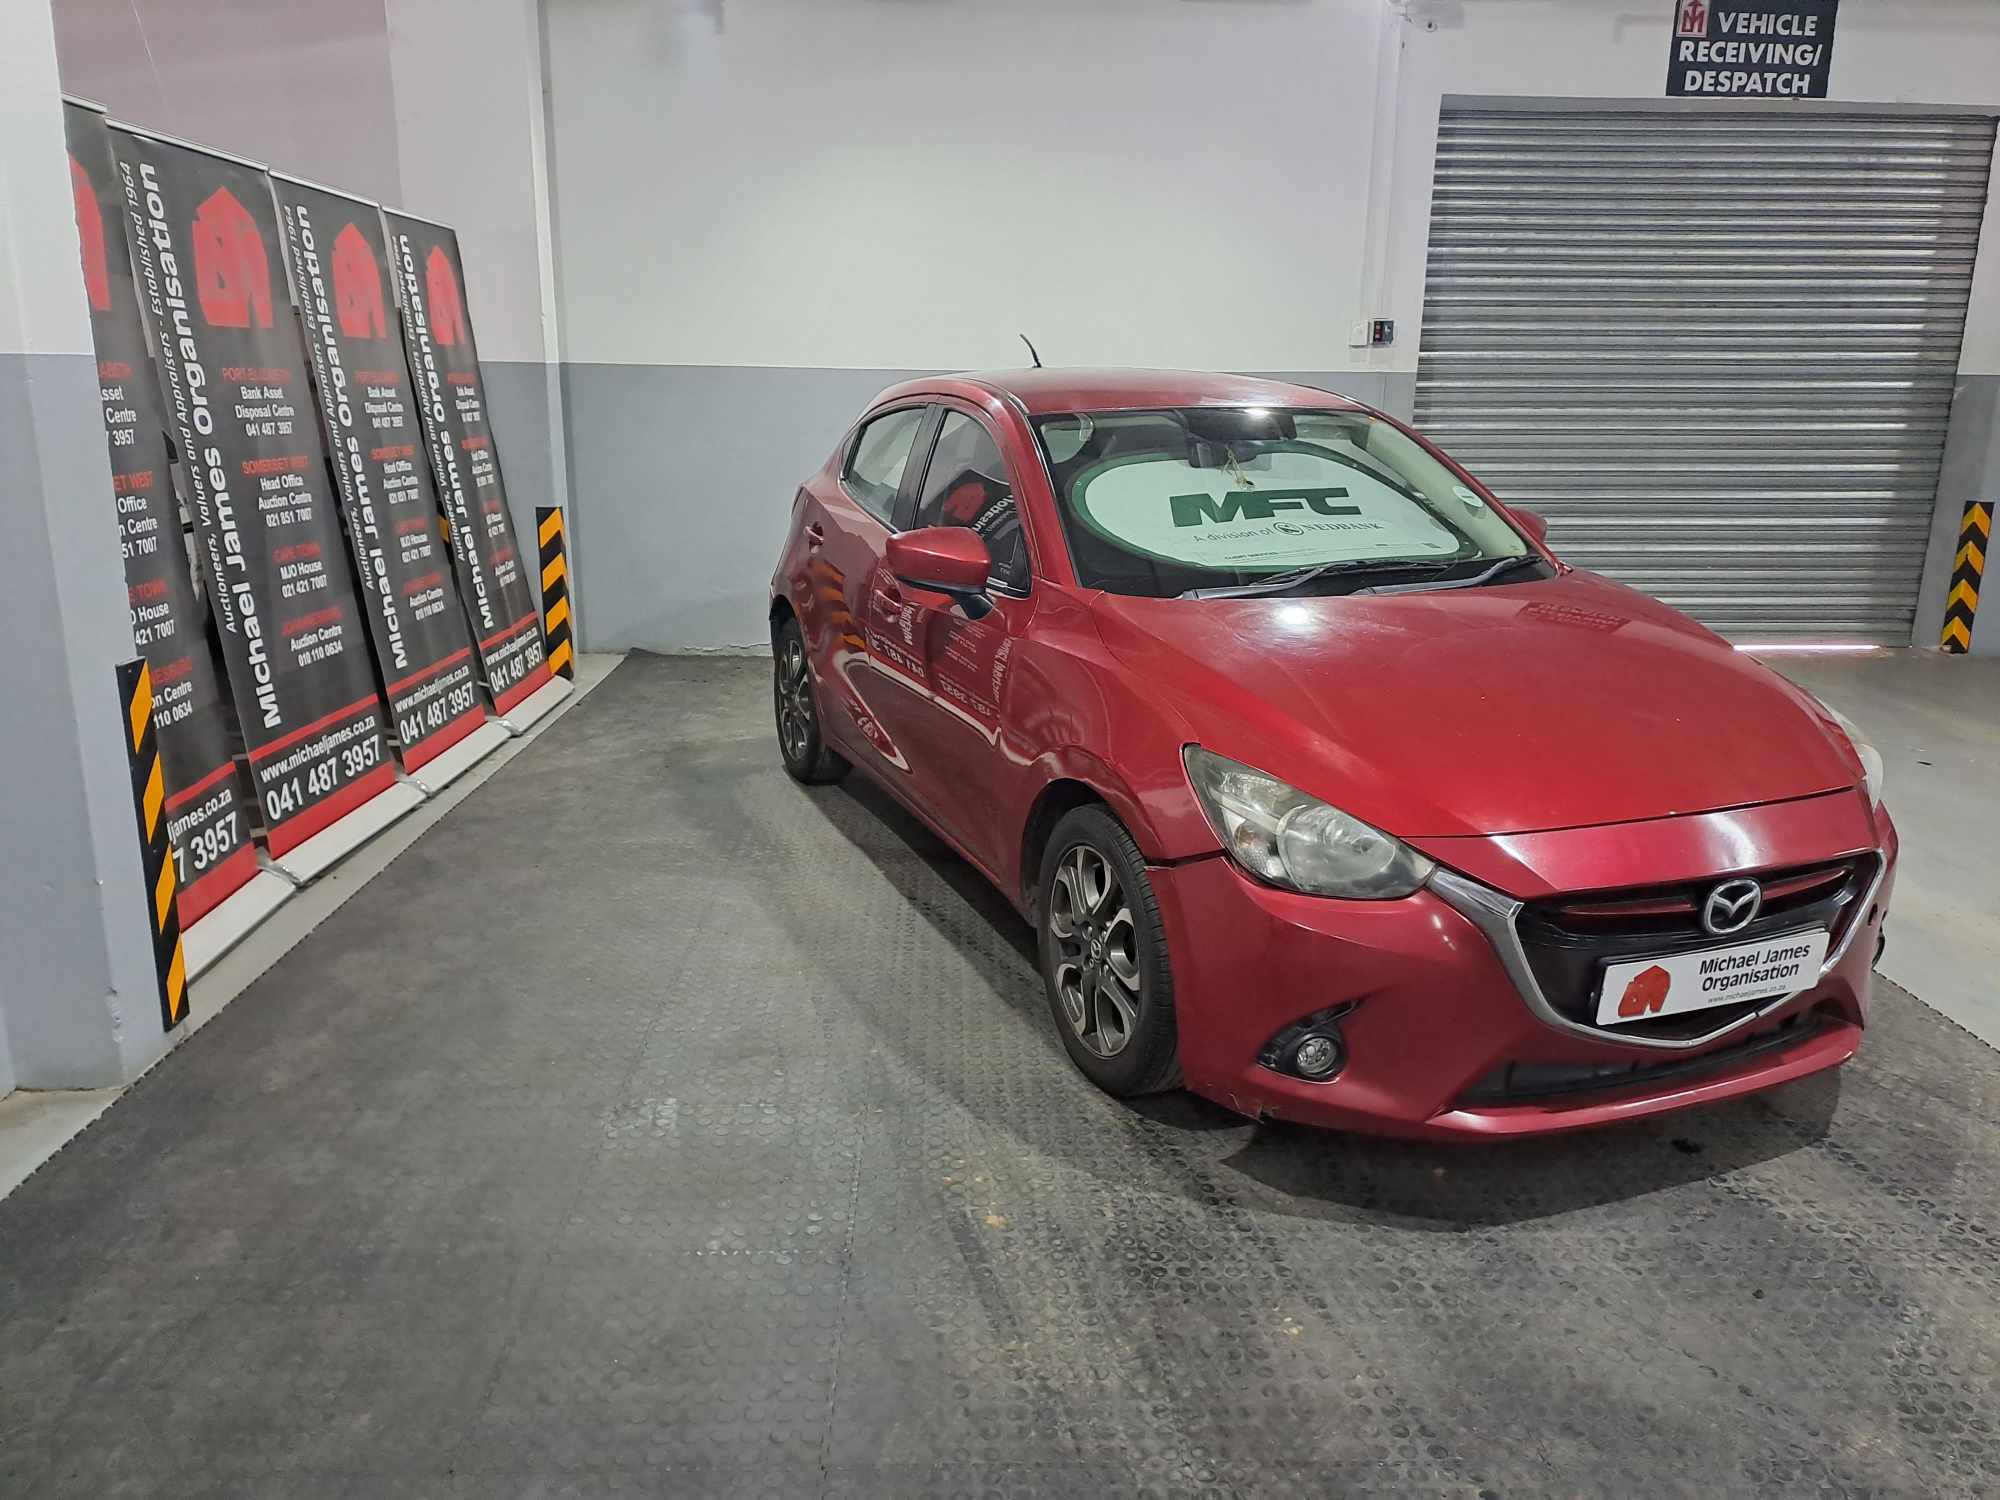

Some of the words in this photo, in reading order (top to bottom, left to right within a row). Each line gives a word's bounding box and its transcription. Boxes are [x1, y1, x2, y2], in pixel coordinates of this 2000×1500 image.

[1717, 12, 1818, 37] VEHICLE
[1678, 40, 1823, 67] RECEIVING/
[1684, 70, 1811, 95] DESPATCH
[118, 161, 138, 206] 1964
[283, 204, 298, 243] 1964
[132, 210, 164, 317] Established
[139, 162, 213, 437] Organisation
[291, 245, 317, 330] Established
[296, 204, 353, 427] Organisation
[399, 234, 446, 423] Organisation
[100, 386, 124, 401] sset
[161, 337, 189, 424] Appraisers
[312, 342, 336, 418] Appraisers
[105, 407, 137, 423] Centre
[234, 403, 271, 420] Disposal
[328, 419, 342, 448] and
[112, 429, 135, 446] 3957
[178, 426, 197, 461] and
[190, 465, 213, 527] Valuers
[336, 450, 354, 502] Valuers
[346, 436, 379, 540] James
[440, 430, 468, 519] James
[117, 496, 148, 513] Office
[127, 516, 158, 534] Centre
[204, 447, 247, 572] James
[1169, 487, 1362, 528] MFC
[135, 536, 158, 556] 7007
[1207, 527, 1258, 541] division
[207, 533, 238, 633] Auctioneers,
[460, 525, 495, 629] Michael
[135, 626, 153, 646] 421
[154, 618, 175, 640] 7007
[137, 602, 169, 623] House
[368, 548, 409, 670] Michael
[231, 581, 283, 729] Michael
[490, 666, 510, 692] 041
[510, 653, 525, 680] 487
[524, 641, 543, 669] 3957
[164, 681, 193, 702] Centre
[172, 699, 193, 722] 0634
[394, 665, 470, 713] www.michaeljames.co.za
[400, 711, 425, 745] 041
[427, 697, 447, 729] 487
[448, 680, 475, 715] 3957
[260, 714, 376, 783] www.michaeljames.co.za
[265, 777, 303, 821] 041
[307, 756, 339, 796] 487
[342, 734, 381, 777] 3957
[190, 811, 238, 870] 3957
[1699, 950, 1761, 975] Michael
[1762, 944, 1811, 964] James
[1702, 963, 1800, 991] Organisation
